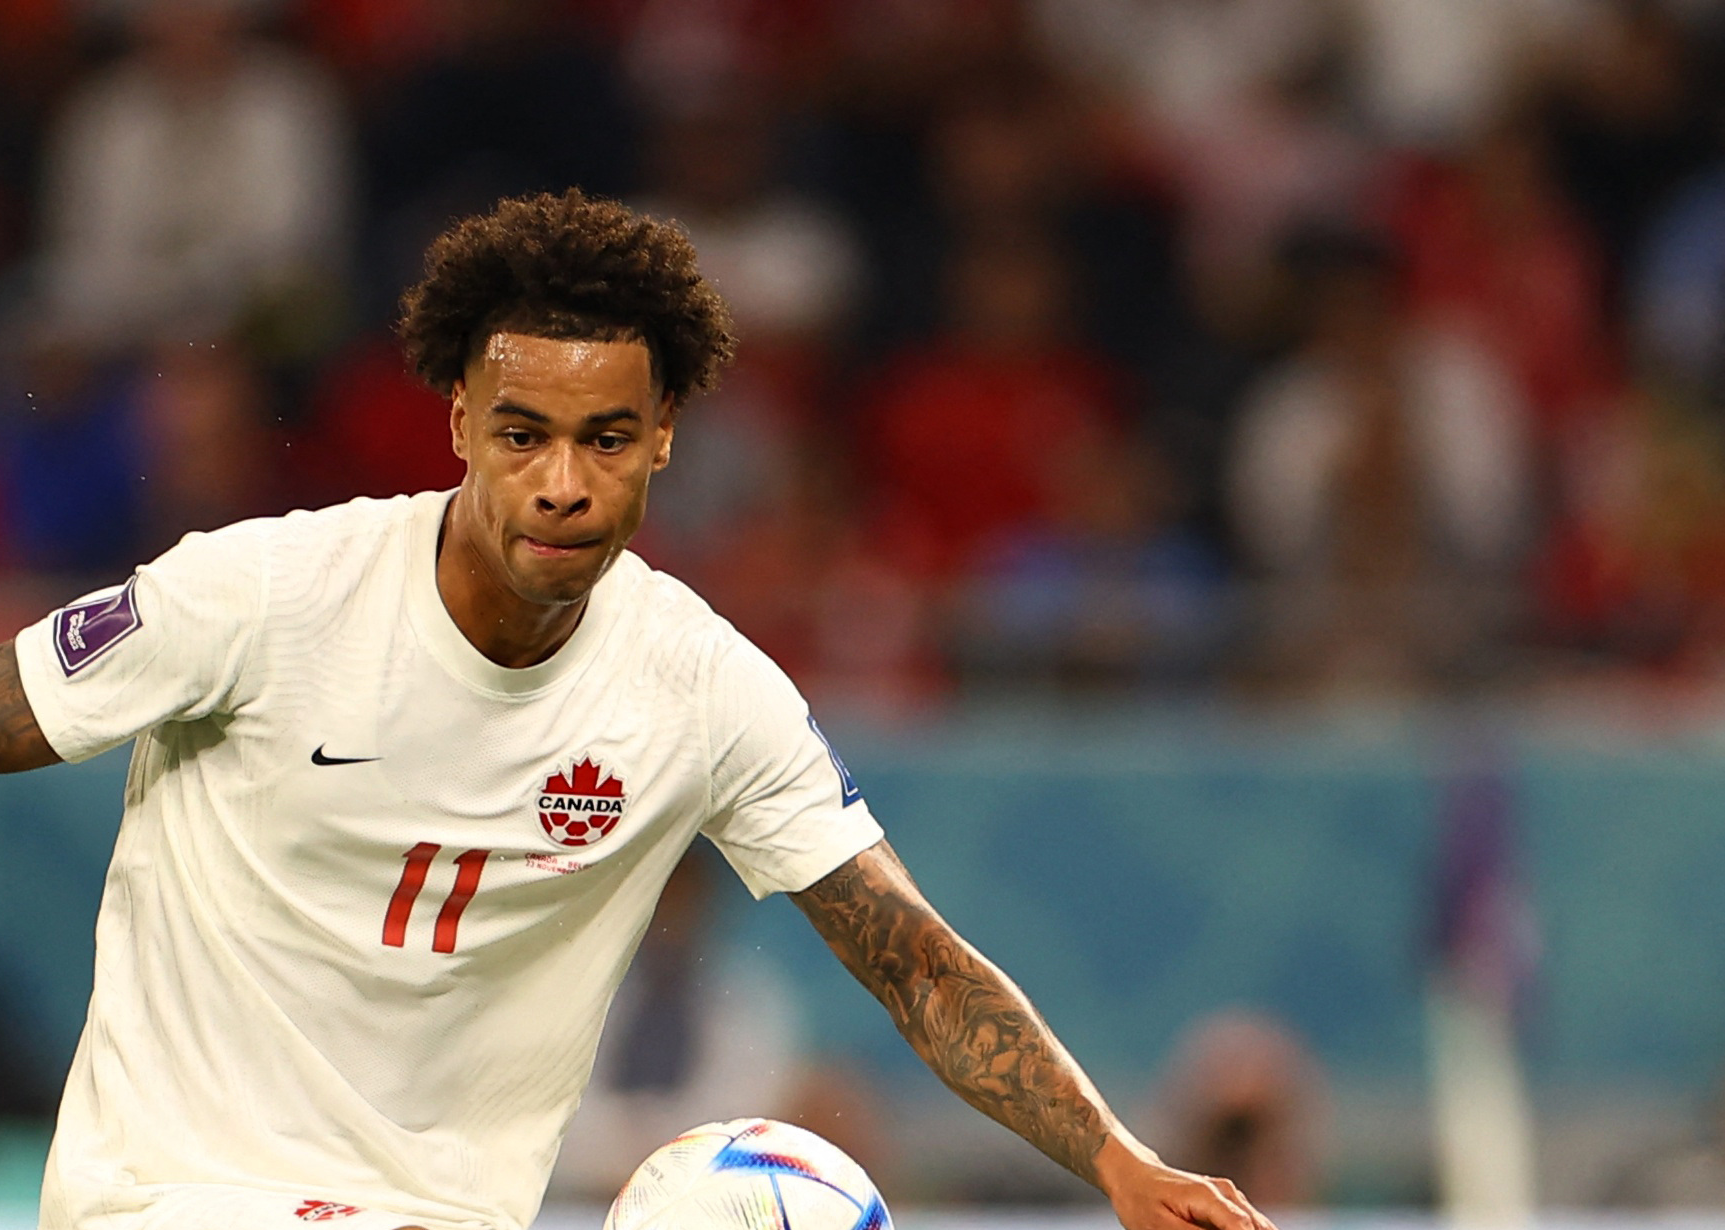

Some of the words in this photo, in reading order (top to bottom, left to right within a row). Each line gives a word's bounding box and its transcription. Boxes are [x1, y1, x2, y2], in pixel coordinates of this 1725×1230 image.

[538, 795, 623, 813] CANADA
[524, 852, 559, 865] CANADA
[382, 841, 492, 954] 11
